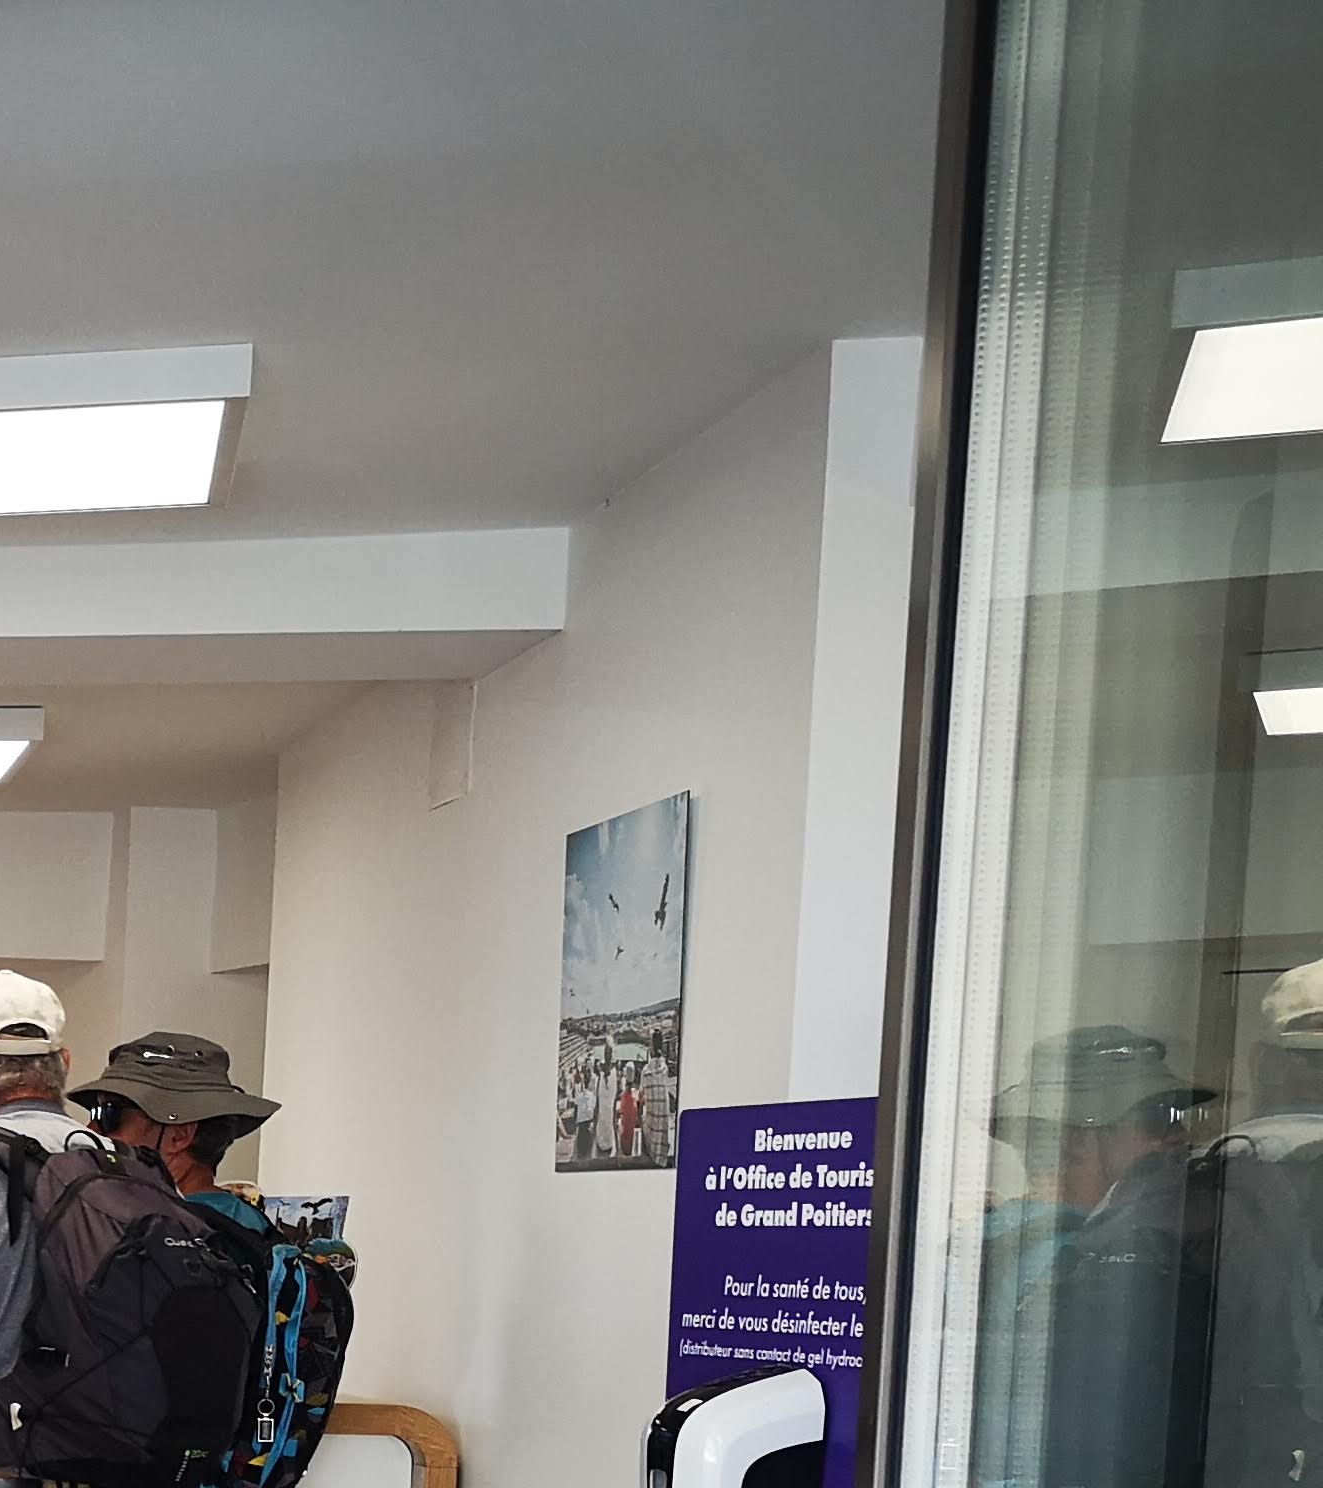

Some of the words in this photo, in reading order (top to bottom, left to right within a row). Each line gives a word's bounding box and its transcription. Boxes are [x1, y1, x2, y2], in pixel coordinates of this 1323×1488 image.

[755, 1127, 853, 1152] Bienvenue
[705, 1166, 717, 1190] à
[719, 1164, 786, 1190] l'Office
[789, 1163, 813, 1189] de
[715, 1202, 737, 1227] de
[740, 1201, 798, 1227] Grand
[724, 1274, 755, 1296] Pour
[756, 1274, 770, 1298] la
[772, 1278, 809, 1299] santé
[812, 1275, 831, 1299] de
[682, 1309, 717, 1328] merci
[718, 1307, 735, 1330] de
[738, 1315, 769, 1332] vous
[771, 1309, 848, 1337] désinfecter
[849, 1312, 864, 1338] le
[733, 1346, 755, 1360] sans
[756, 1348, 791, 1363] contact
[792, 1346, 806, 1363] de
[807, 1348, 824, 1369] gel
